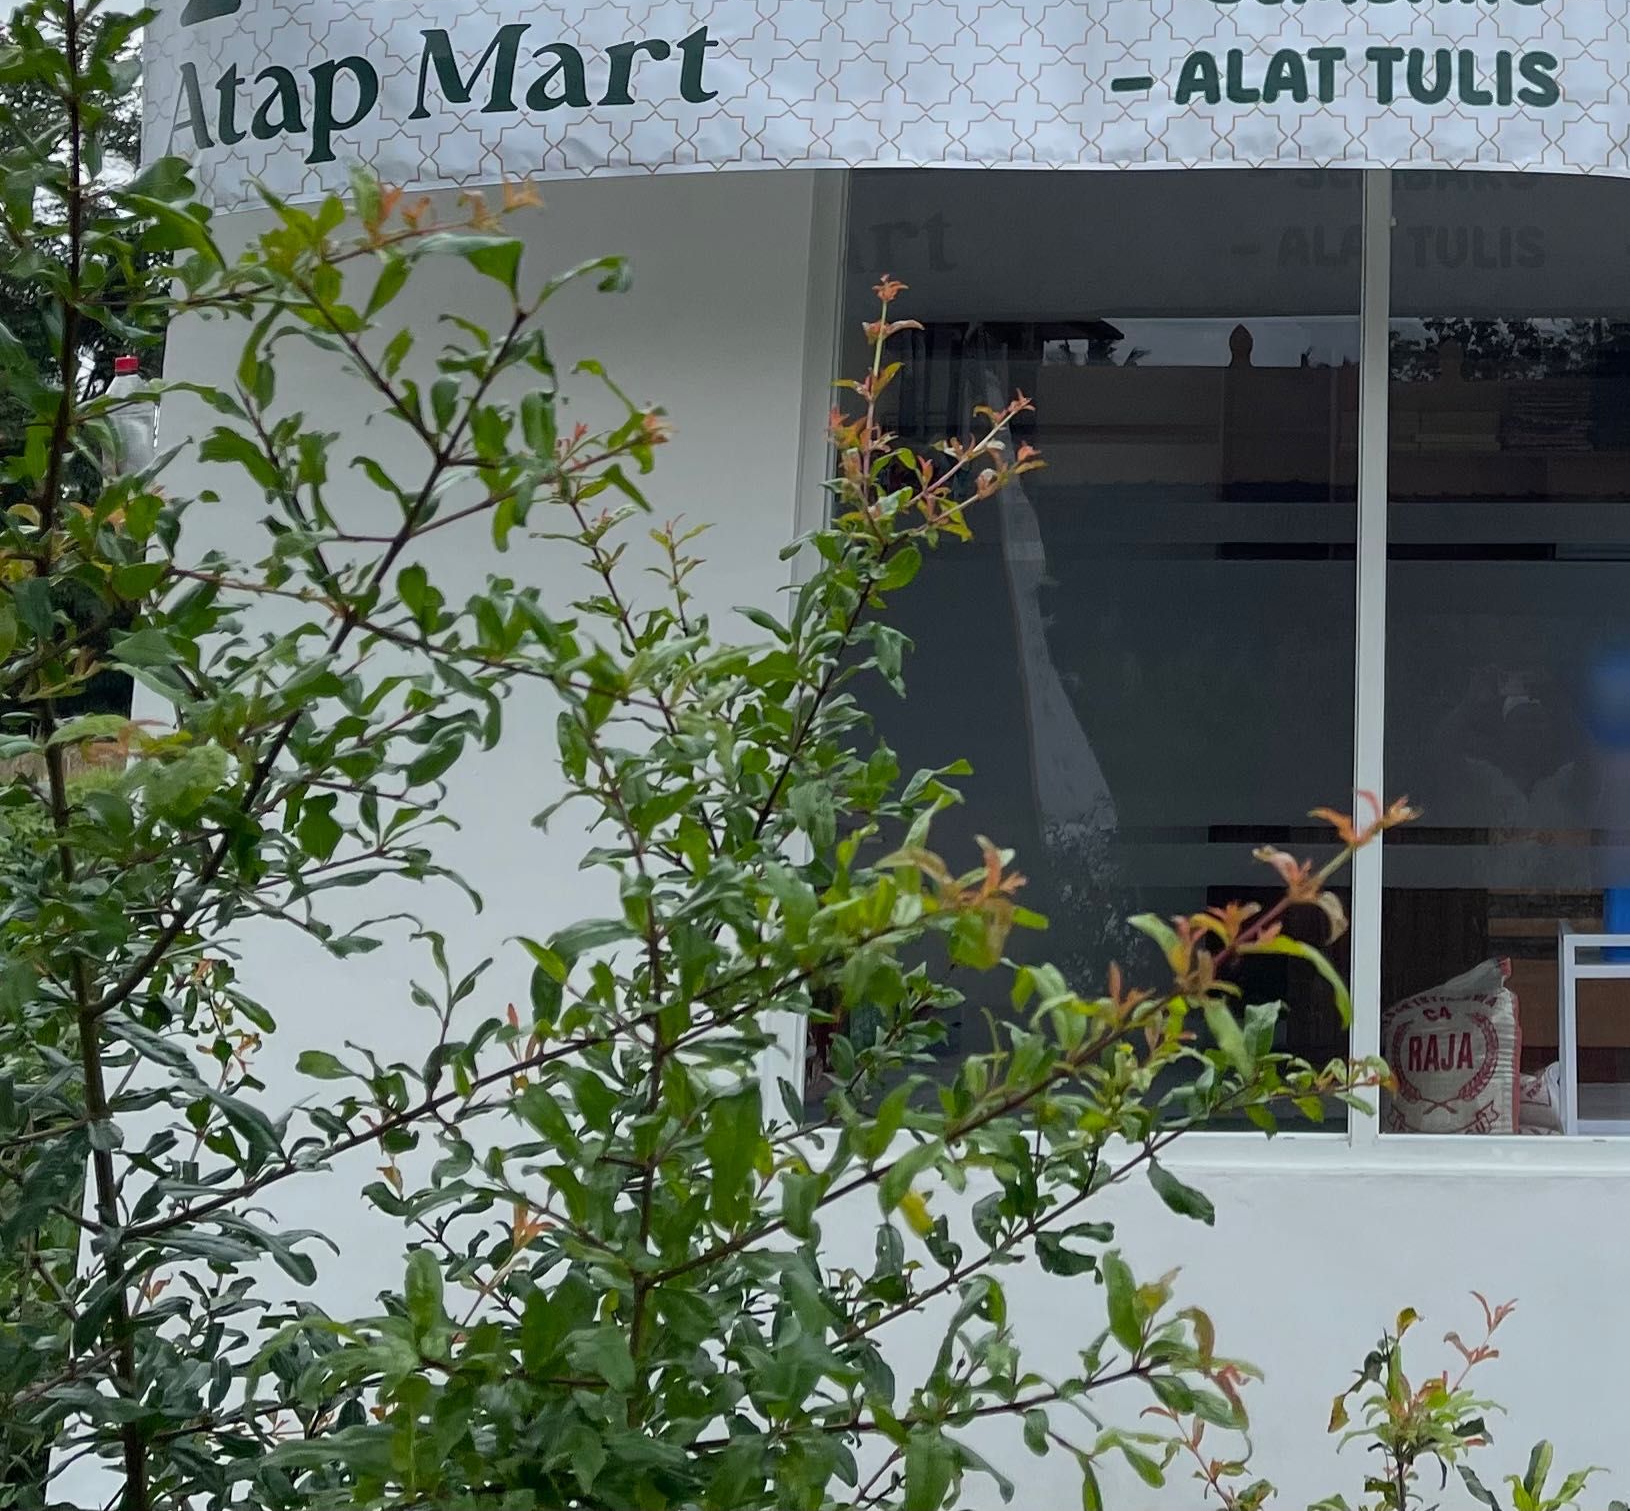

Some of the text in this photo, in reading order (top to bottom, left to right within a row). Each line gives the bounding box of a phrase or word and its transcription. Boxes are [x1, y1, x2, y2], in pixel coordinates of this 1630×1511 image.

[165, 24, 719, 164] Atap Mart
[1175, 47, 1346, 105] ALAT
[1365, 47, 1560, 107] TULIS
[1407, 1032, 1474, 1073] RAJA
